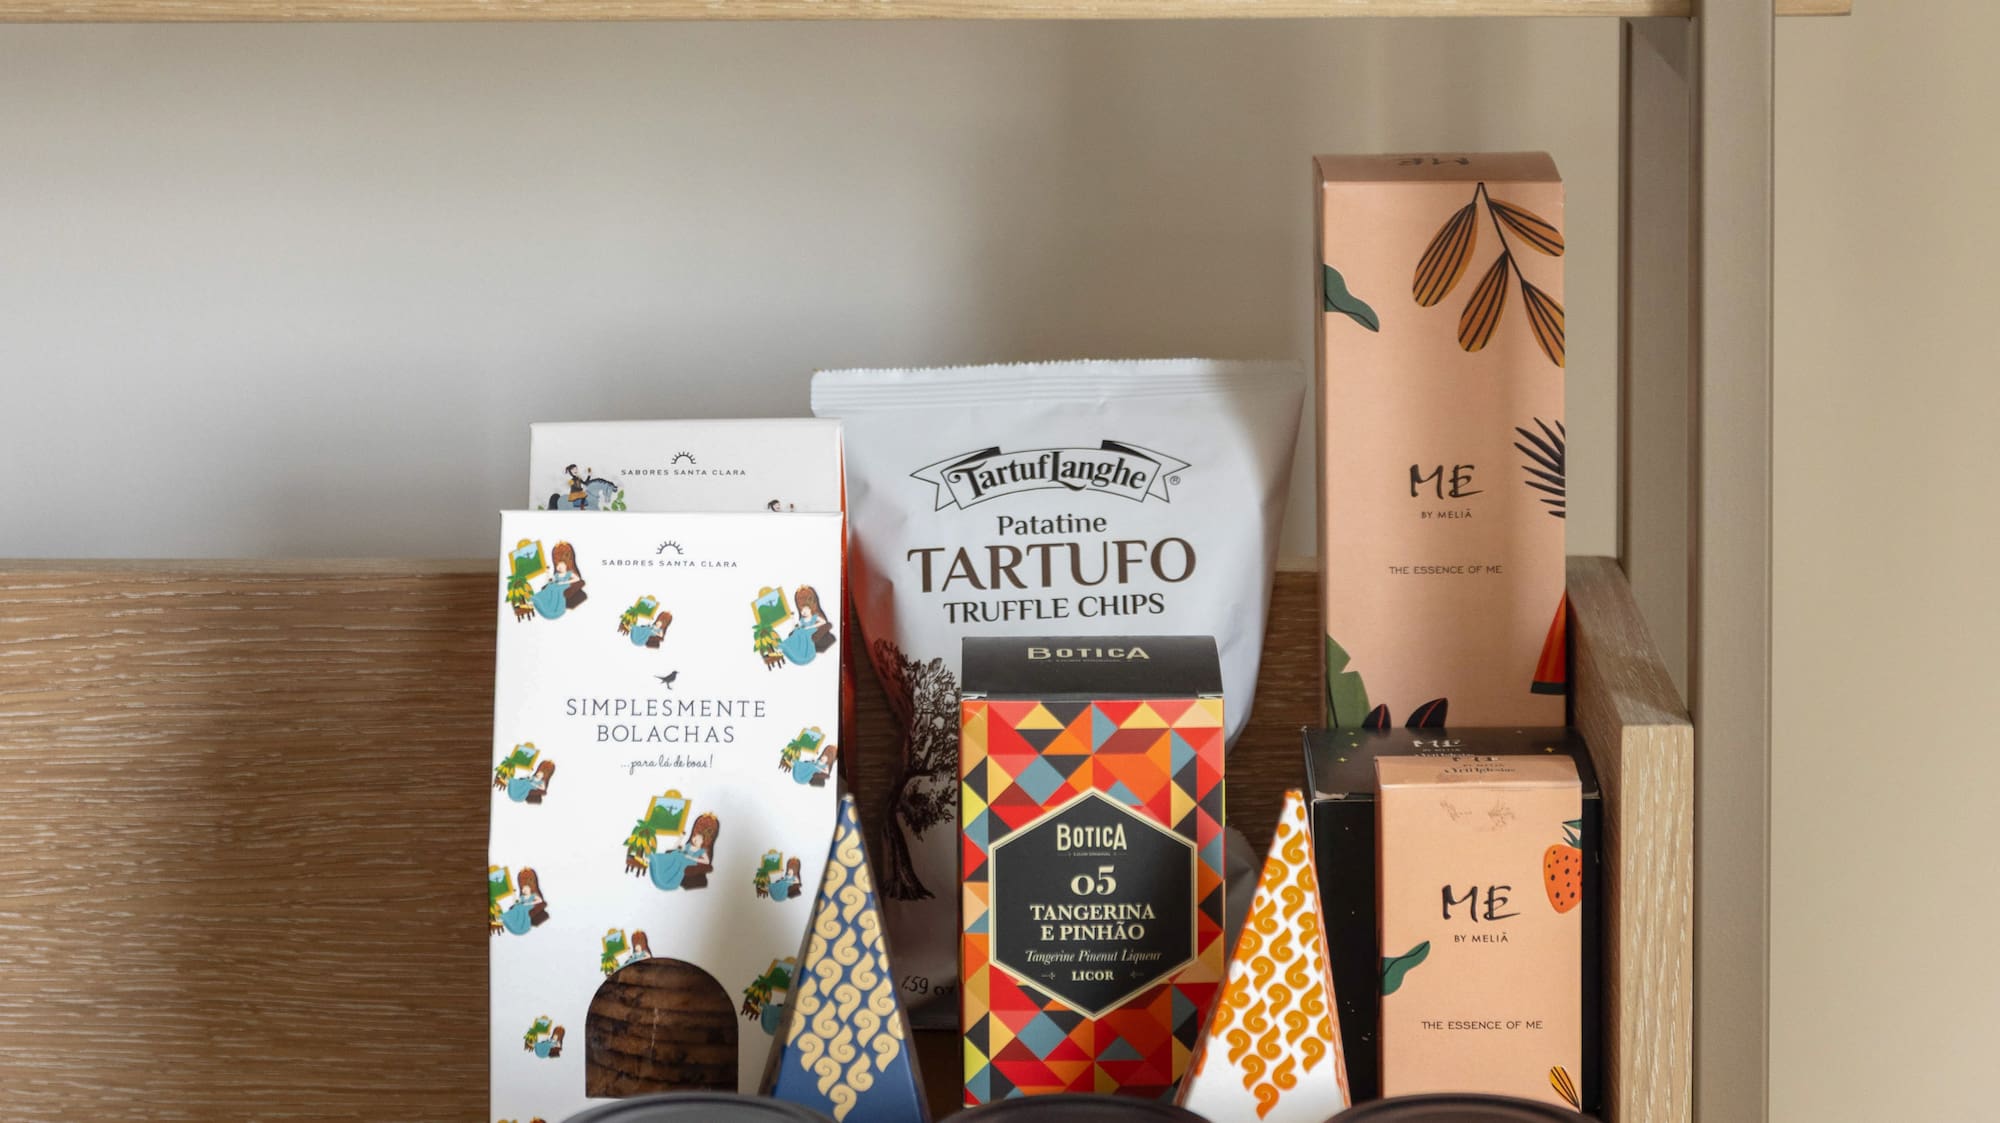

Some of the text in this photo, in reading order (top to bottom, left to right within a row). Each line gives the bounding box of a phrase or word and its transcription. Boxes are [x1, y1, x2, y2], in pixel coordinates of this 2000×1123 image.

[948, 451, 1147, 500] TartufLanghe
[1410, 464, 1484, 500] ME
[1421, 511, 1433, 519] BY
[997, 513, 1108, 536] Patatine
[601, 559, 654, 567] SABORES
[907, 537, 1197, 593] TARTUFO
[1389, 565, 1503, 575] THE ESSENCE OF ME
[943, 592, 1165, 624] TRUFFLE CHIPS
[566, 698, 767, 718] SIMPLESMENTE
[597, 725, 736, 744] BOLACHAS
[673, 754, 685, 768] de
[1030, 903, 1156, 921] TANGERINA
[1442, 884, 1521, 923] ME
[1041, 921, 1145, 941] E PINHÃO
[1454, 934, 1467, 943] BY
[1025, 948, 1162, 966] Tangerine Pinenut Liqueur
[1071, 971, 1115, 982] LICOR
[1422, 1020, 1543, 1030] THE ESSENCE OF ME
